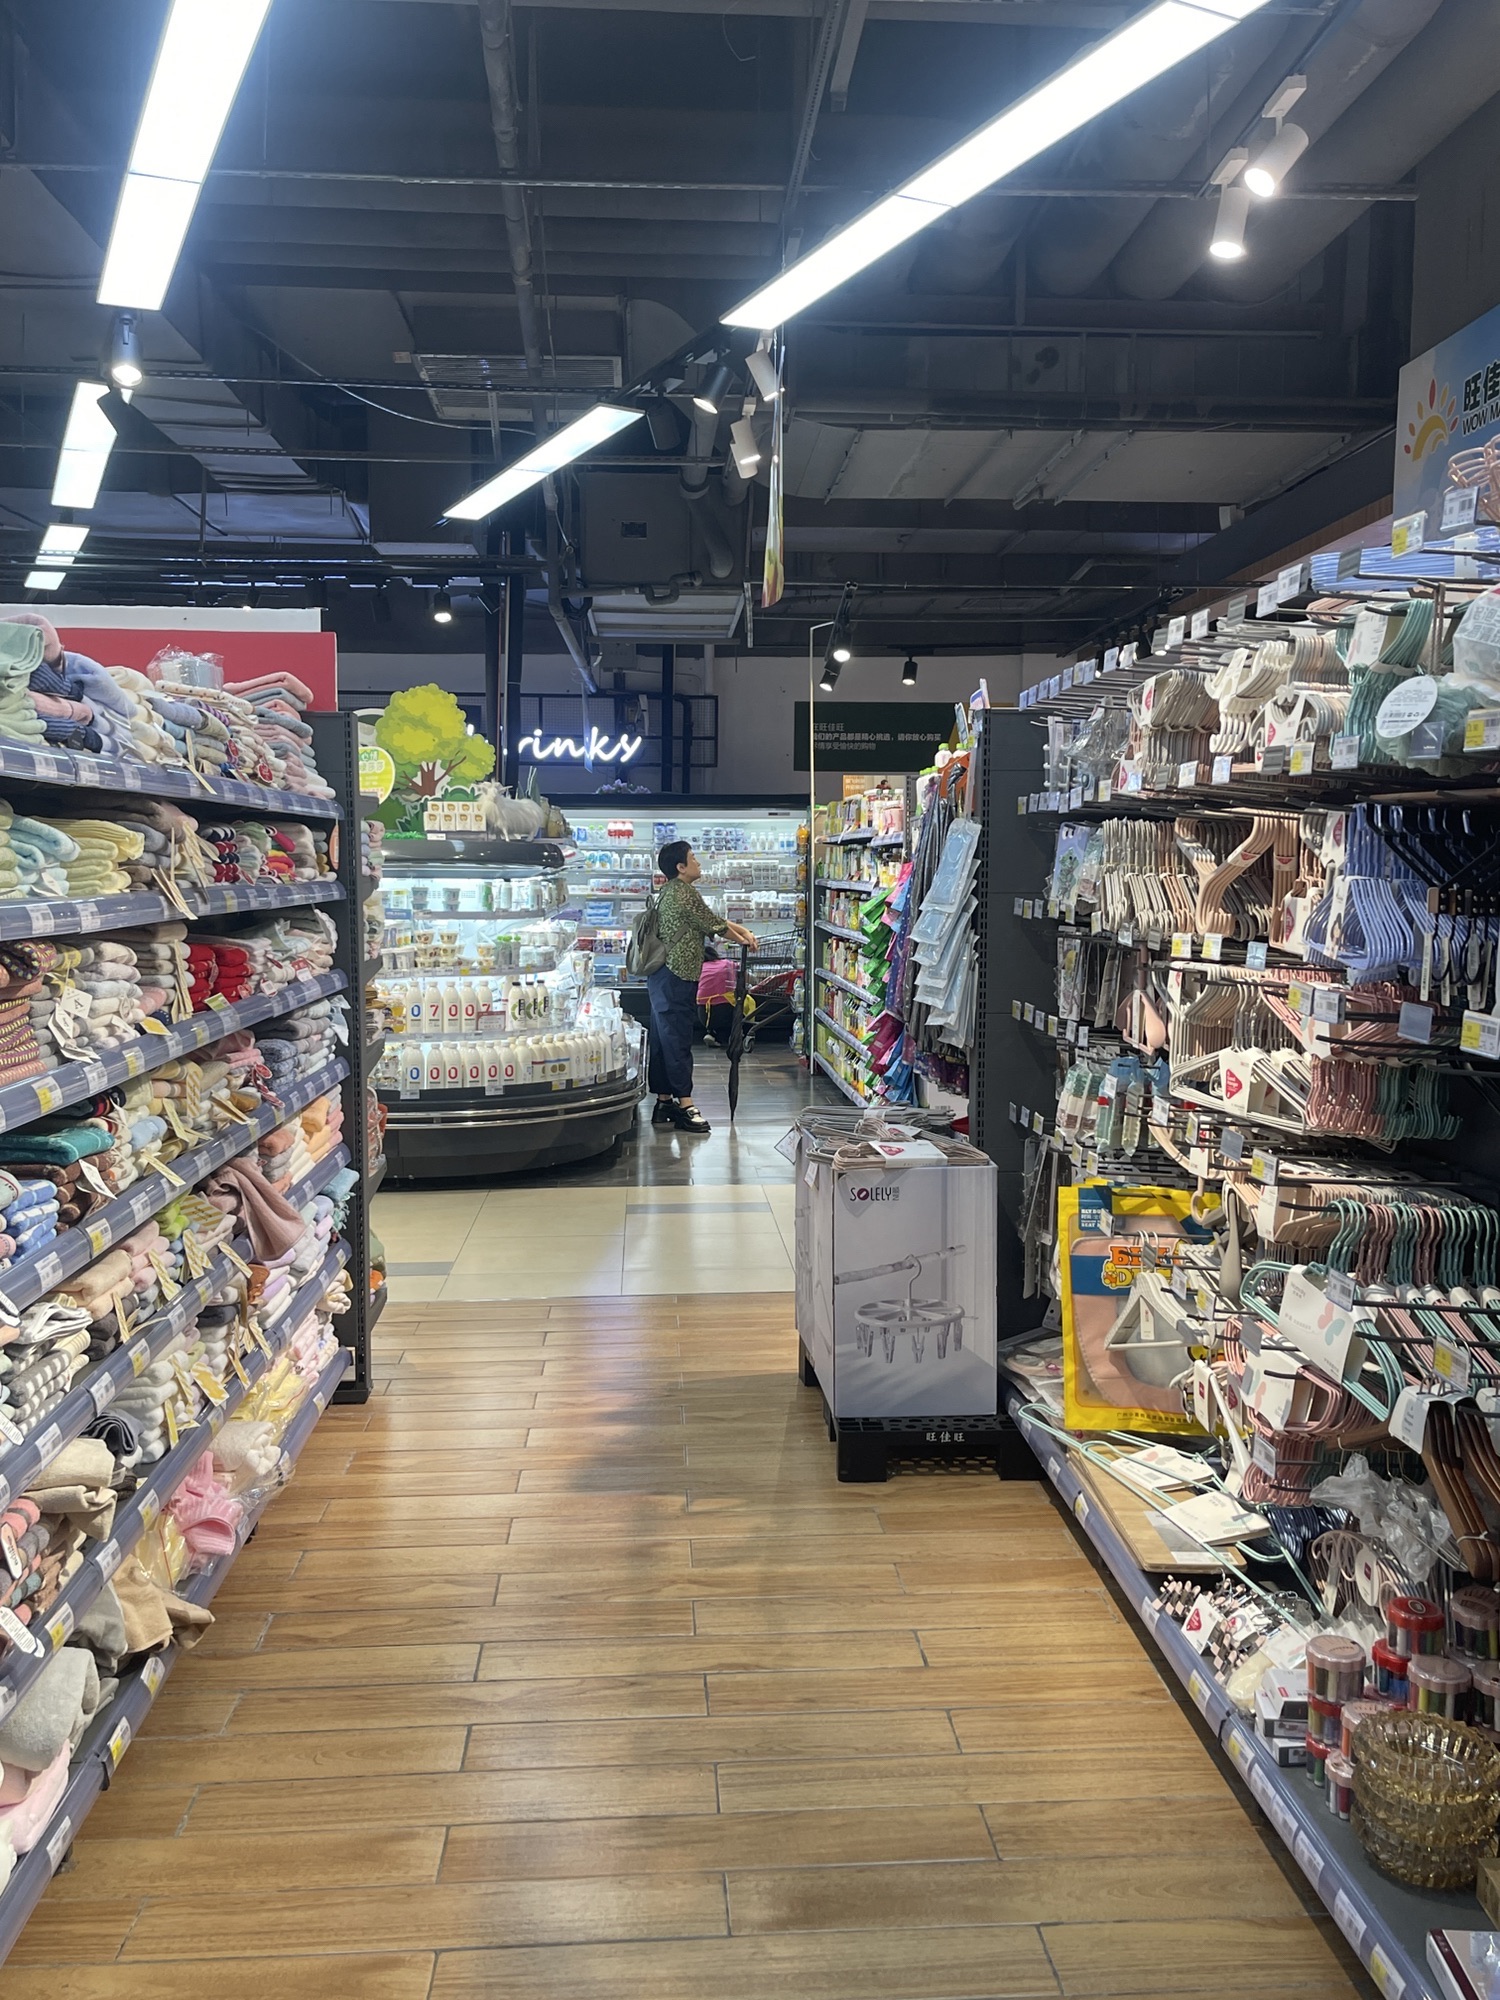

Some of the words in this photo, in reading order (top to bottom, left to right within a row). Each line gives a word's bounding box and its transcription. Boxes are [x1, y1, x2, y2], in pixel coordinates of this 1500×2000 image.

[1462, 407, 1488, 436] WOW
[1490, 400, 1500, 422] M
[850, 1187, 892, 1202] SOLELY
[925, 1431, 966, 1443] 旺佳旺
